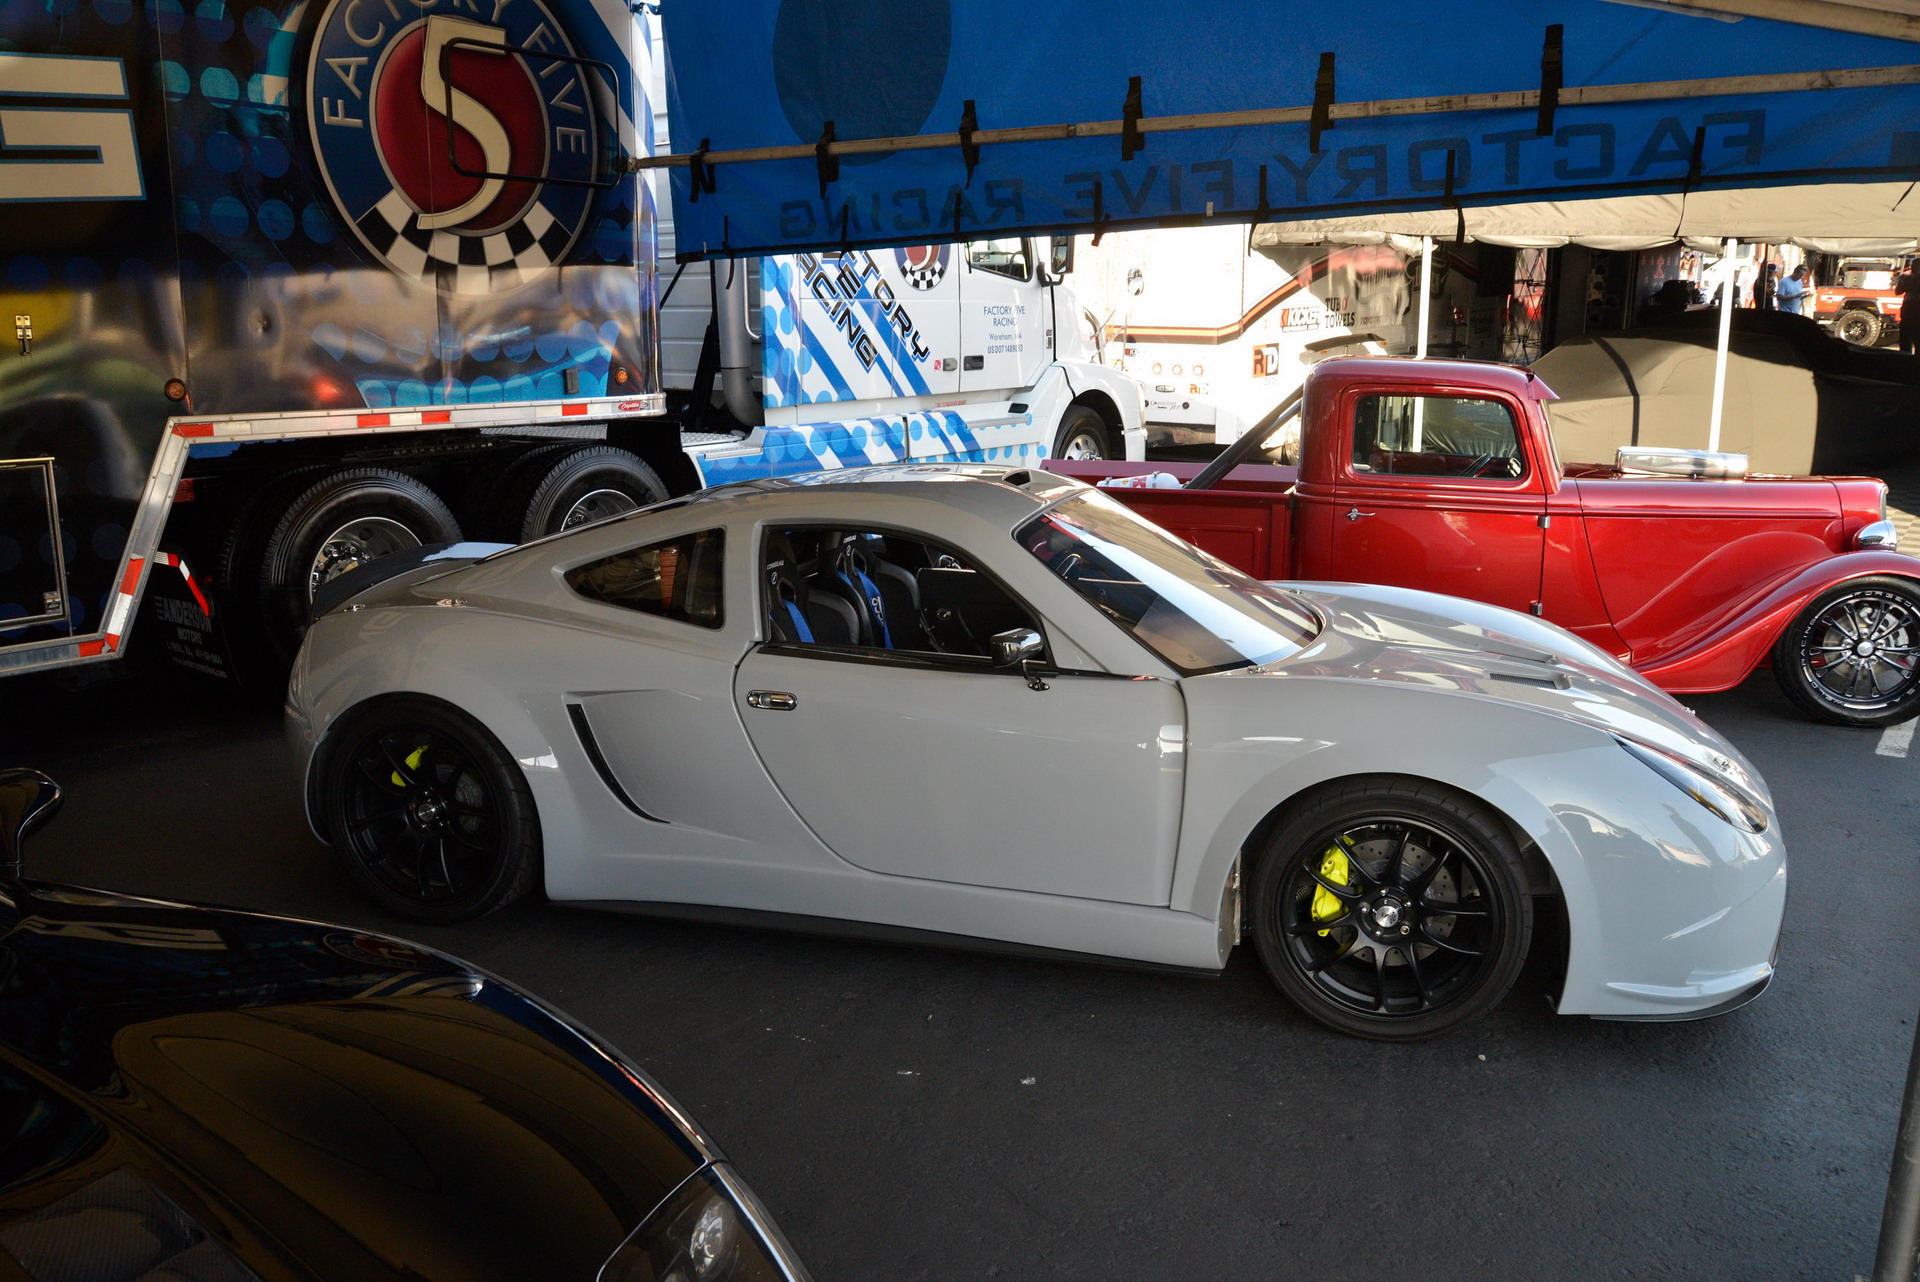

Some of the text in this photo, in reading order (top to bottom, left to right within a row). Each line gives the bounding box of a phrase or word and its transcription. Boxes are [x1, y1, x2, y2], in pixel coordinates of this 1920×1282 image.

[522, 22, 588, 155] FIVE
[983, 305, 1012, 316] FACTORY
[1325, 297, 1340, 311] TUB
[1325, 312, 1355, 328] TOWELS
[1852, 590, 1913, 608] FORGED
